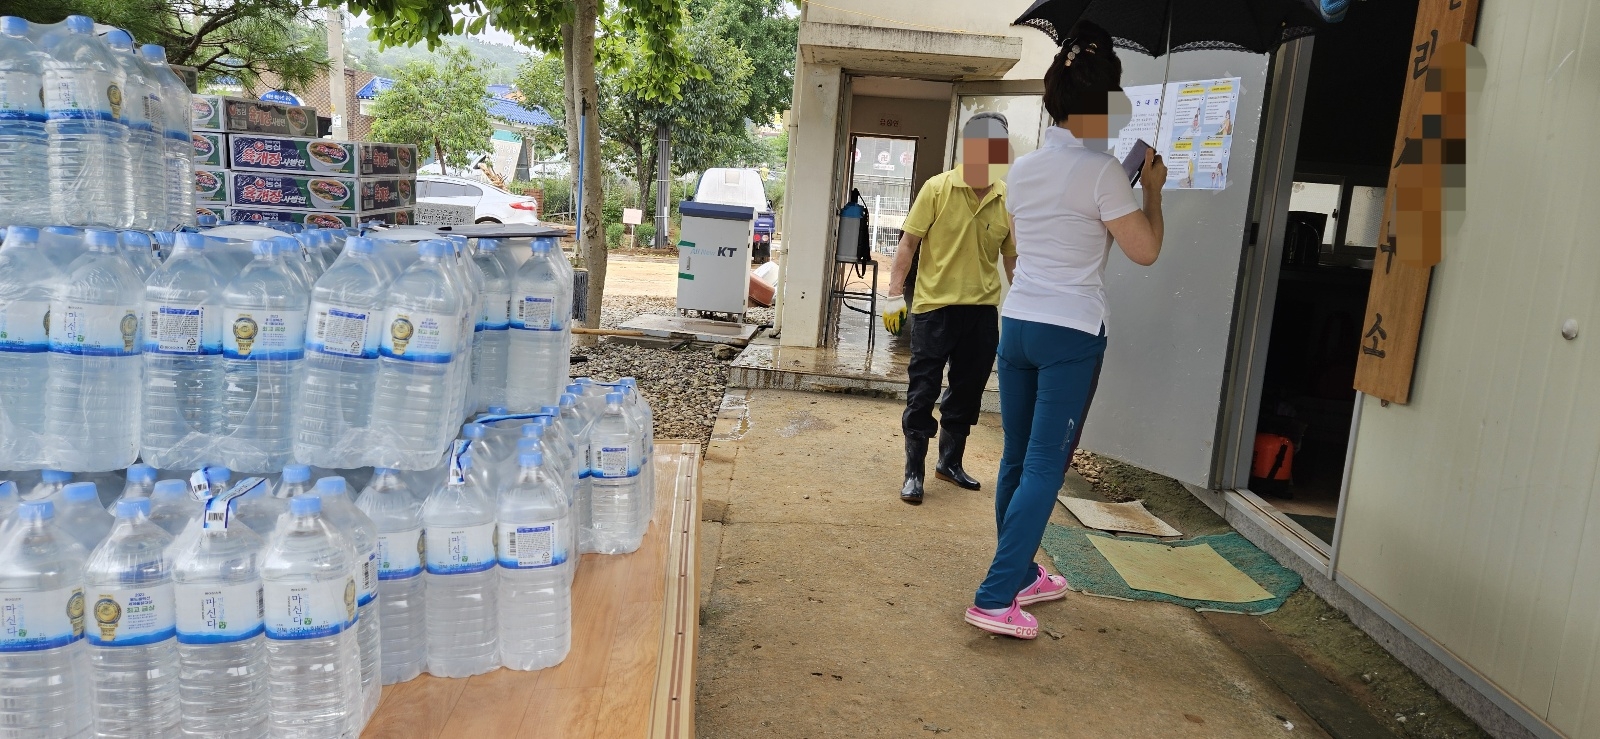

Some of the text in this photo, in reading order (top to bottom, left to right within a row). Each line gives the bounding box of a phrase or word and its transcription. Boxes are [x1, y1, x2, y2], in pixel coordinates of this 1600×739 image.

[249, 106, 272, 126] 육개장
[242, 147, 305, 167] 육개장 사발면
[265, 143, 280, 151] 농심
[243, 184, 306, 204] 육개장 사발면
[717, 246, 737, 257] KT
[67, 311, 78, 341] 마신다
[452, 535, 461, 562] 마신다
[205, 597, 217, 629] 마신다
[291, 593, 303, 625] 마신다
[6, 603, 18, 636] 마신다
[1016, 627, 1038, 636] croc
